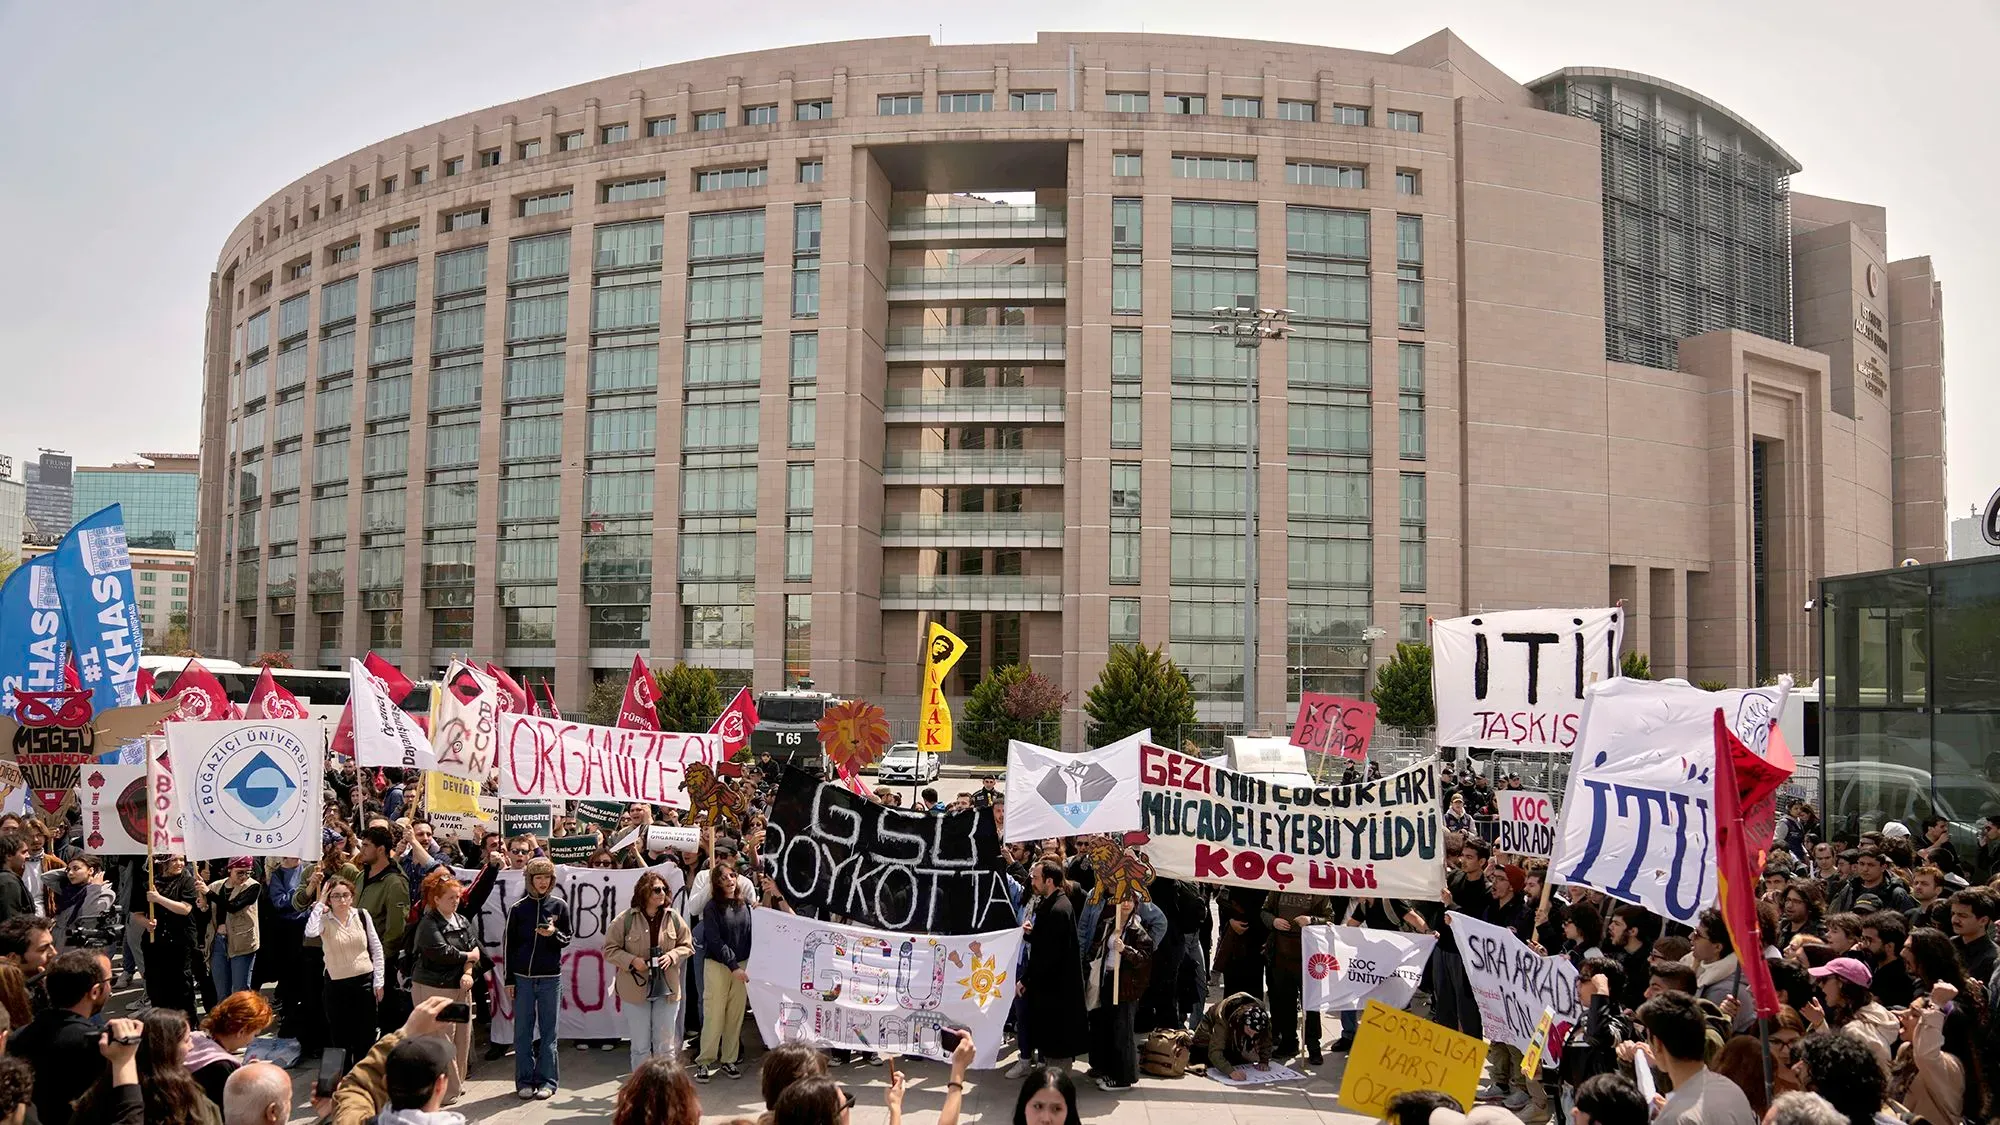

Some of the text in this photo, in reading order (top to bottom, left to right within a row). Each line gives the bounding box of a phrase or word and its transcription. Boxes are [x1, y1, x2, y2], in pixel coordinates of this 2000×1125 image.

[91, 575, 136, 685] KHAS
[187, 693, 205, 708] TİP
[12, 723, 95, 755] MSGSÜ
[776, 732, 802, 745] T 65
[18, 764, 81, 789] BURADA
[200, 729, 308, 805] BOĞAZİÇİ ÜNİVERSİTESİ
[1271, 764, 1437, 811] ÇOCUKLARI
[153, 774, 172, 848] BOUN
[512, 822, 543, 830] AYAKTA
[598, 809, 620, 818] YAPMA
[1512, 796, 1550, 826] KOÇ
[244, 832, 283, 844] 1863
[1565, 750, 1710, 921] İTÜ
[1194, 843, 1295, 891] KOÇ
[1348, 957, 1377, 972] KOÇ
[1468, 934, 1510, 982] SIRA
[1367, 1005, 1478, 1069] ZORBALIĞA
[1379, 1044, 1448, 1088] KARŞI
